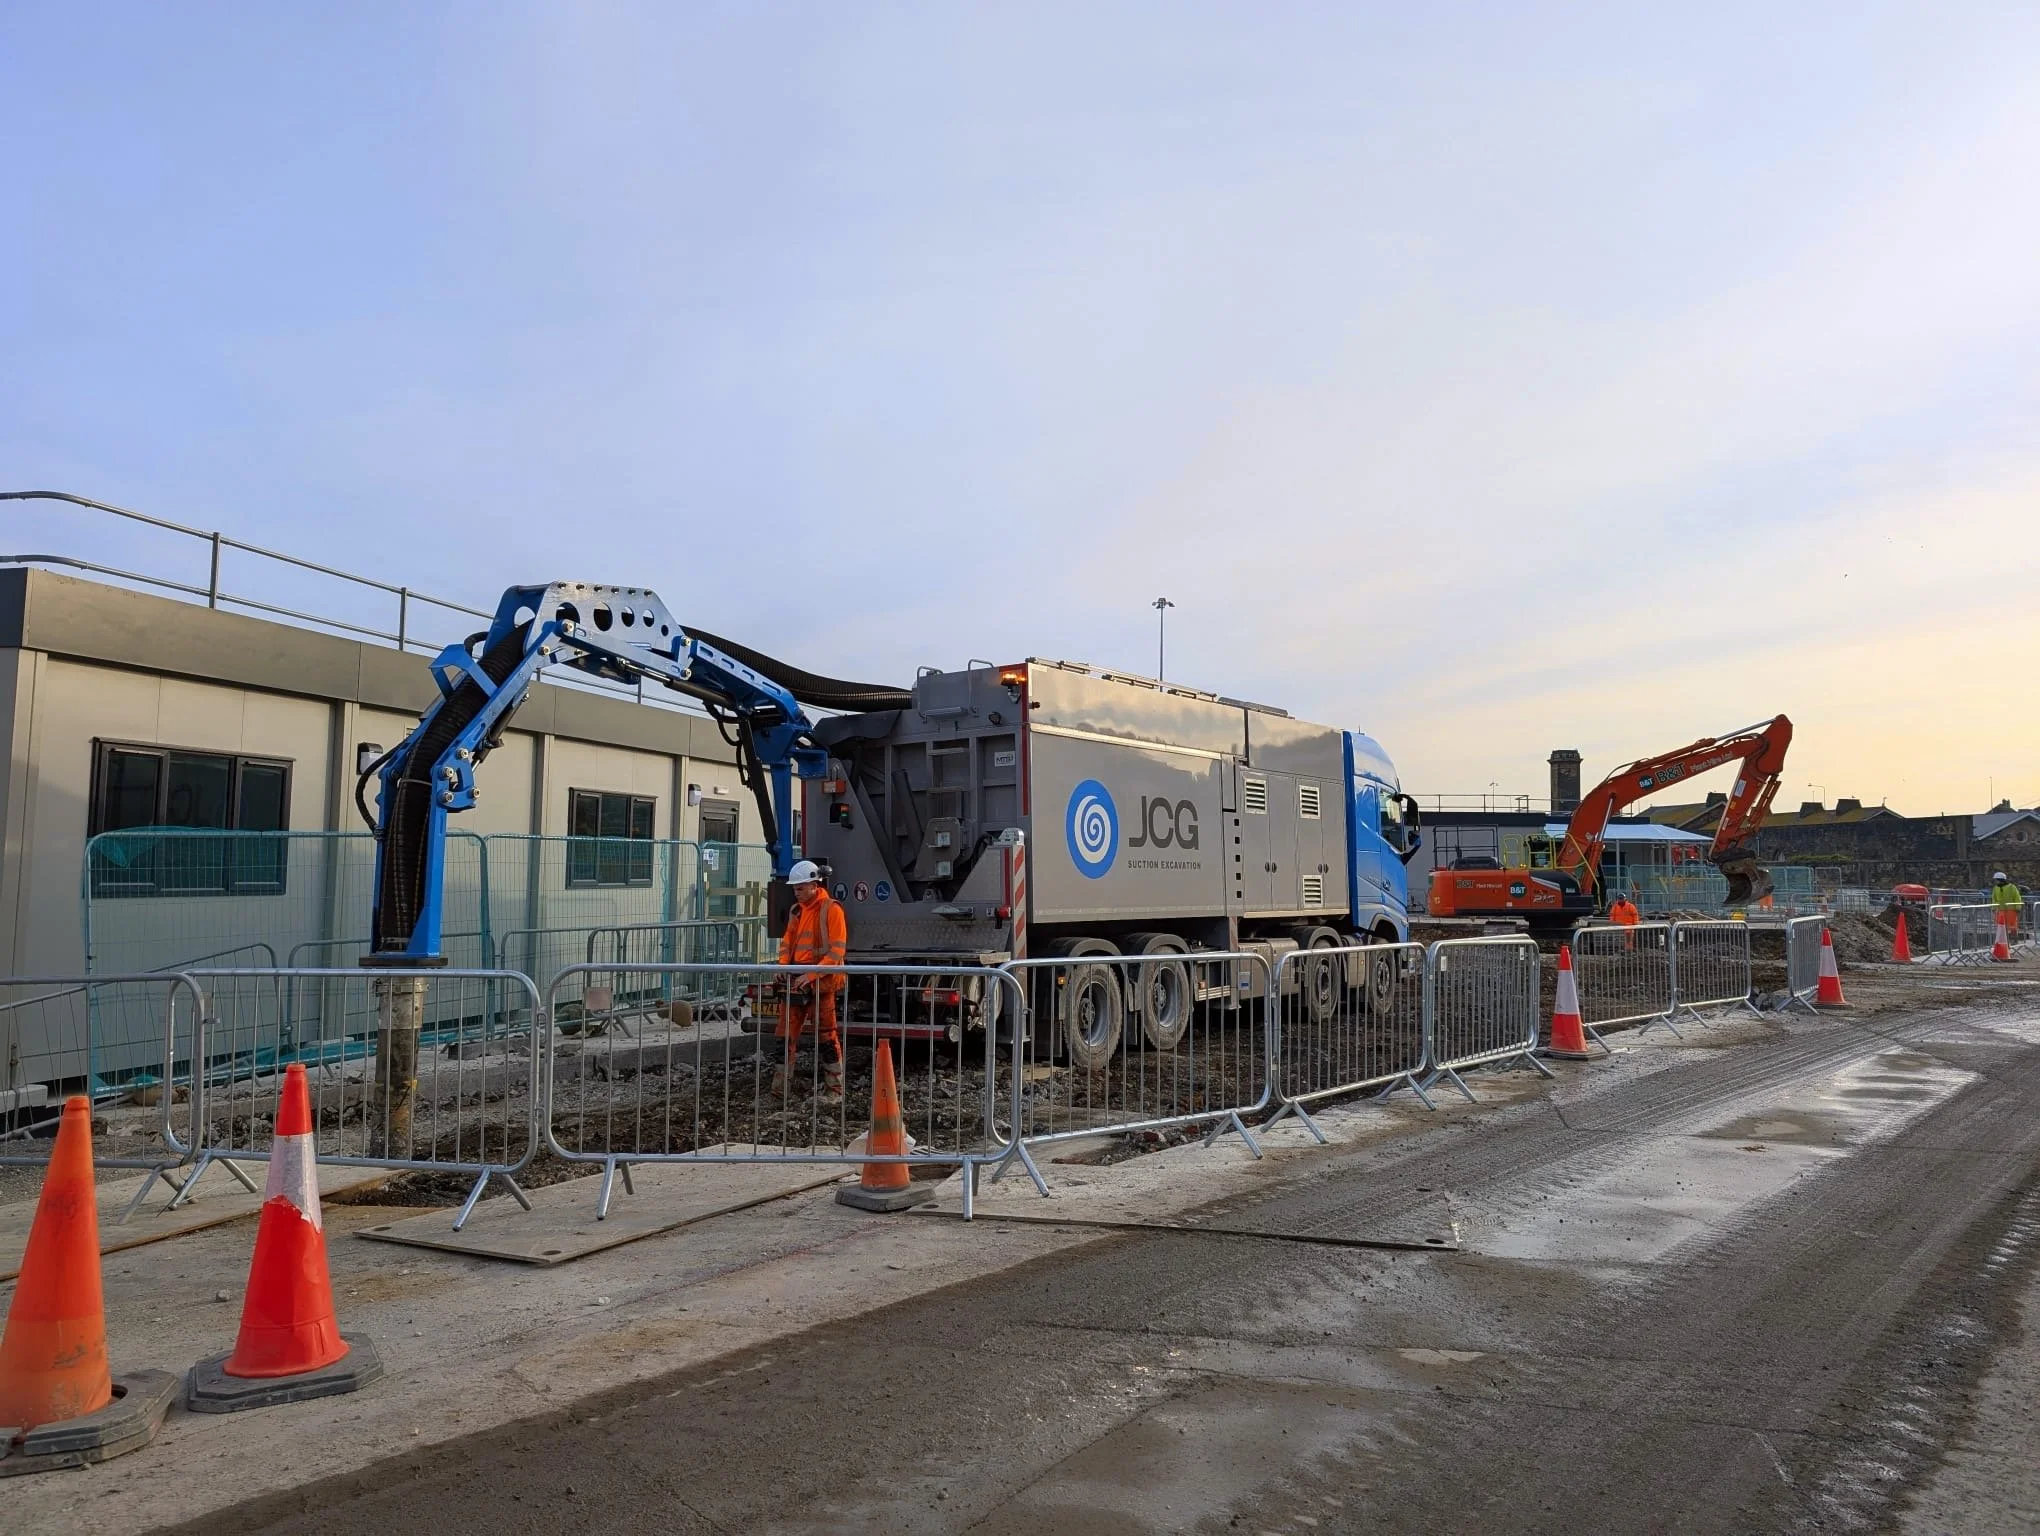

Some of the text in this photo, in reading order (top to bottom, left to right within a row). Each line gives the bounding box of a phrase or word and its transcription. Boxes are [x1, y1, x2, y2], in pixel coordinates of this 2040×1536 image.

[1655, 762, 1685, 784] B&T
[1639, 778, 1653, 788] B&T
[1129, 796, 1199, 850] JCG
[1128, 860, 1201, 870] SUCTION EXCAVATION
[1510, 886, 1526, 894] B&T
